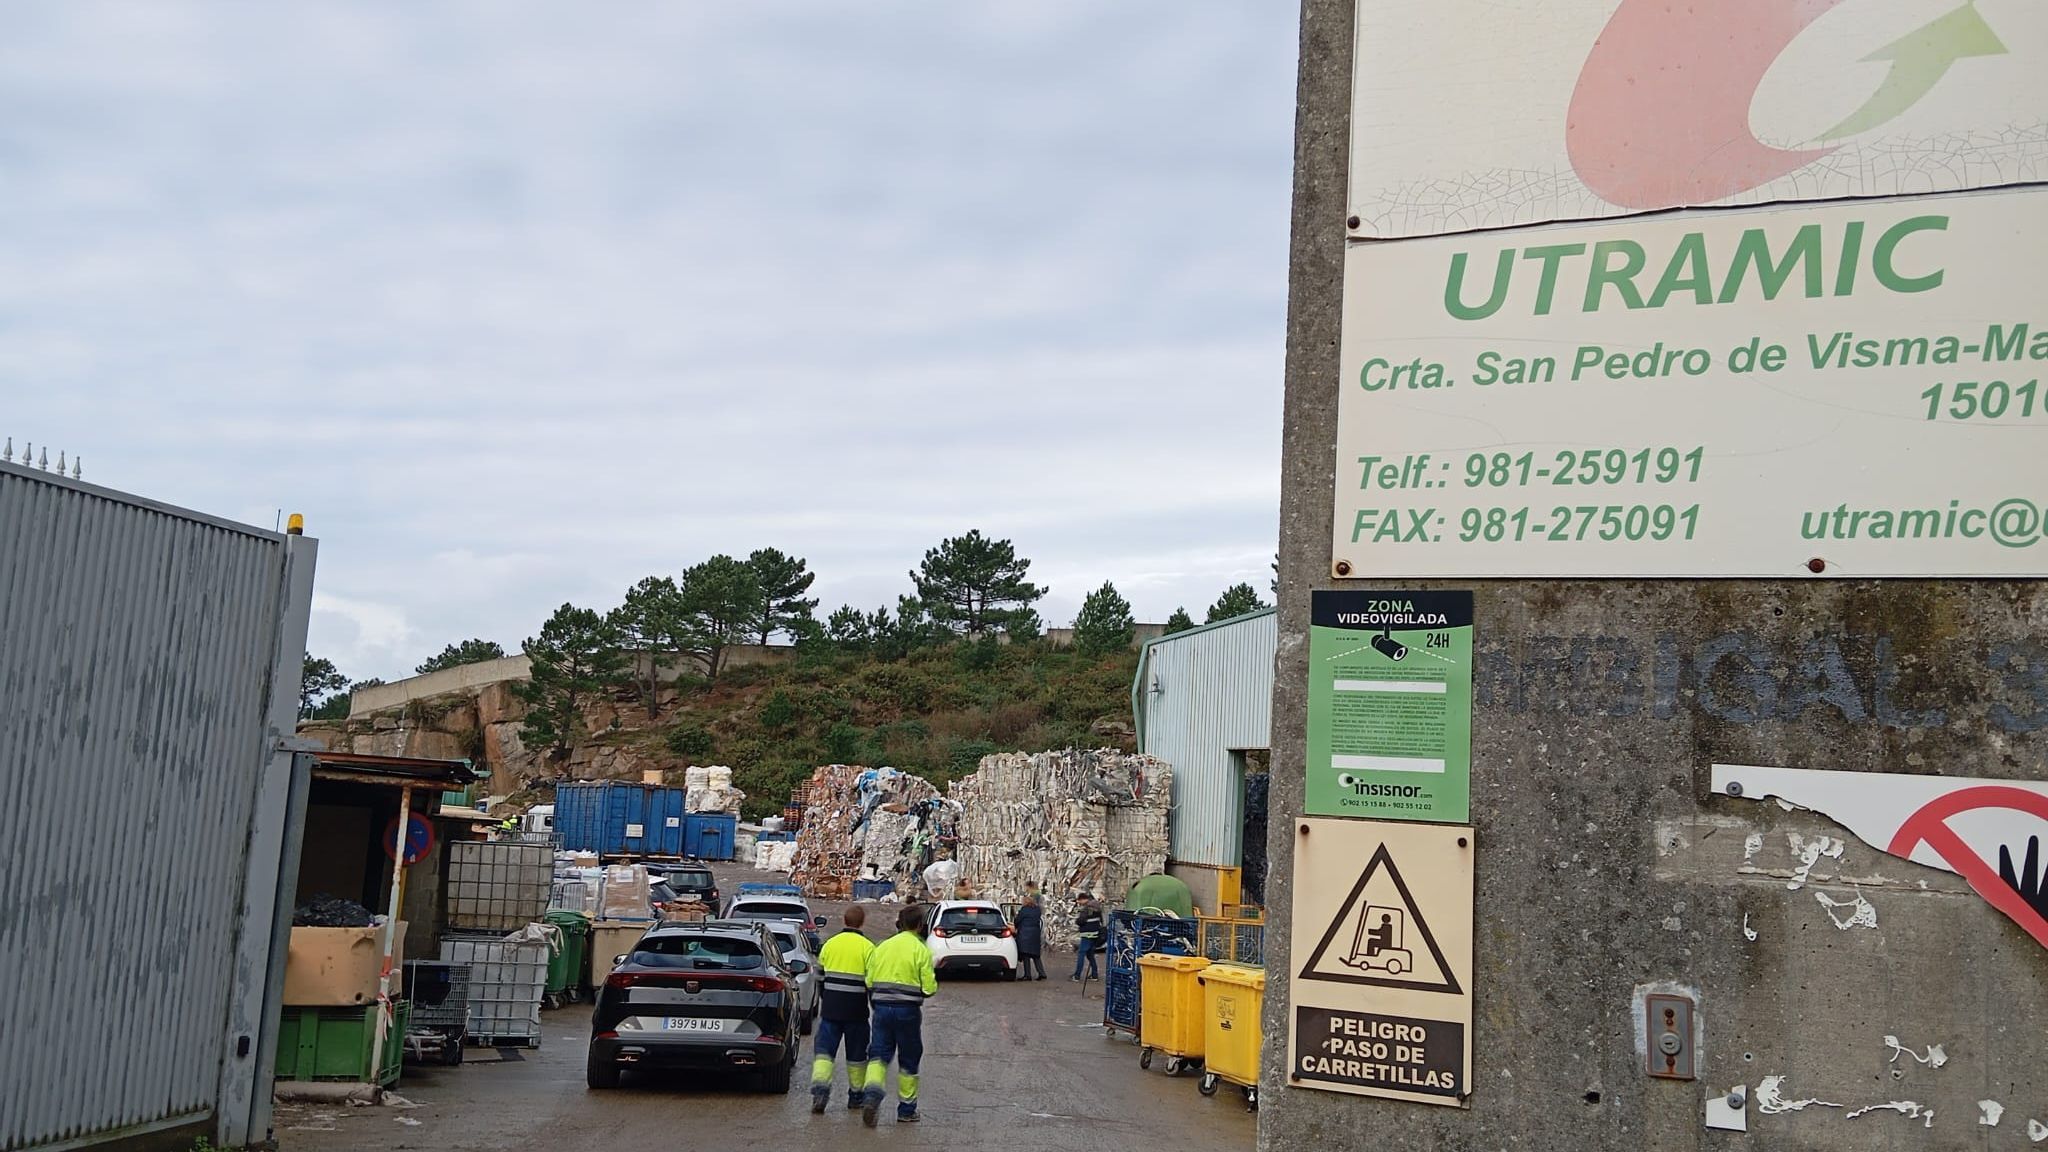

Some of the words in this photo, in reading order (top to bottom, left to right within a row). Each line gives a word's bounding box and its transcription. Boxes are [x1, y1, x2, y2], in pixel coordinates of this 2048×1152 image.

[1444, 215, 1949, 320] UTRAMIC
[1360, 357, 1455, 391] Crta.
[1472, 351, 1556, 385] San
[1571, 339, 1711, 380] Pedro
[1728, 336, 1787, 373] de
[1920, 378, 2048, 420] 1501
[1357, 454, 1449, 489] Telf.:
[1463, 446, 1704, 487] 981-259191
[1351, 507, 1445, 543] FAX:
[1459, 503, 1700, 543] 981-275091
[1801, 497, 2048, 547] utramic@
[1337, 613, 1448, 625] VIDEOVIGILADA
[1367, 600, 1415, 613] ZONA
[1426, 633, 1450, 648] 24H
[670, 1018, 698, 1030] 3979
[699, 1019, 721, 1031] MJS
[1330, 1016, 1426, 1043] PELIGRO
[1330, 1038, 1388, 1060] PASO
[1395, 1045, 1425, 1065] DE
[1301, 1055, 1455, 1089] CARRETILLAS
